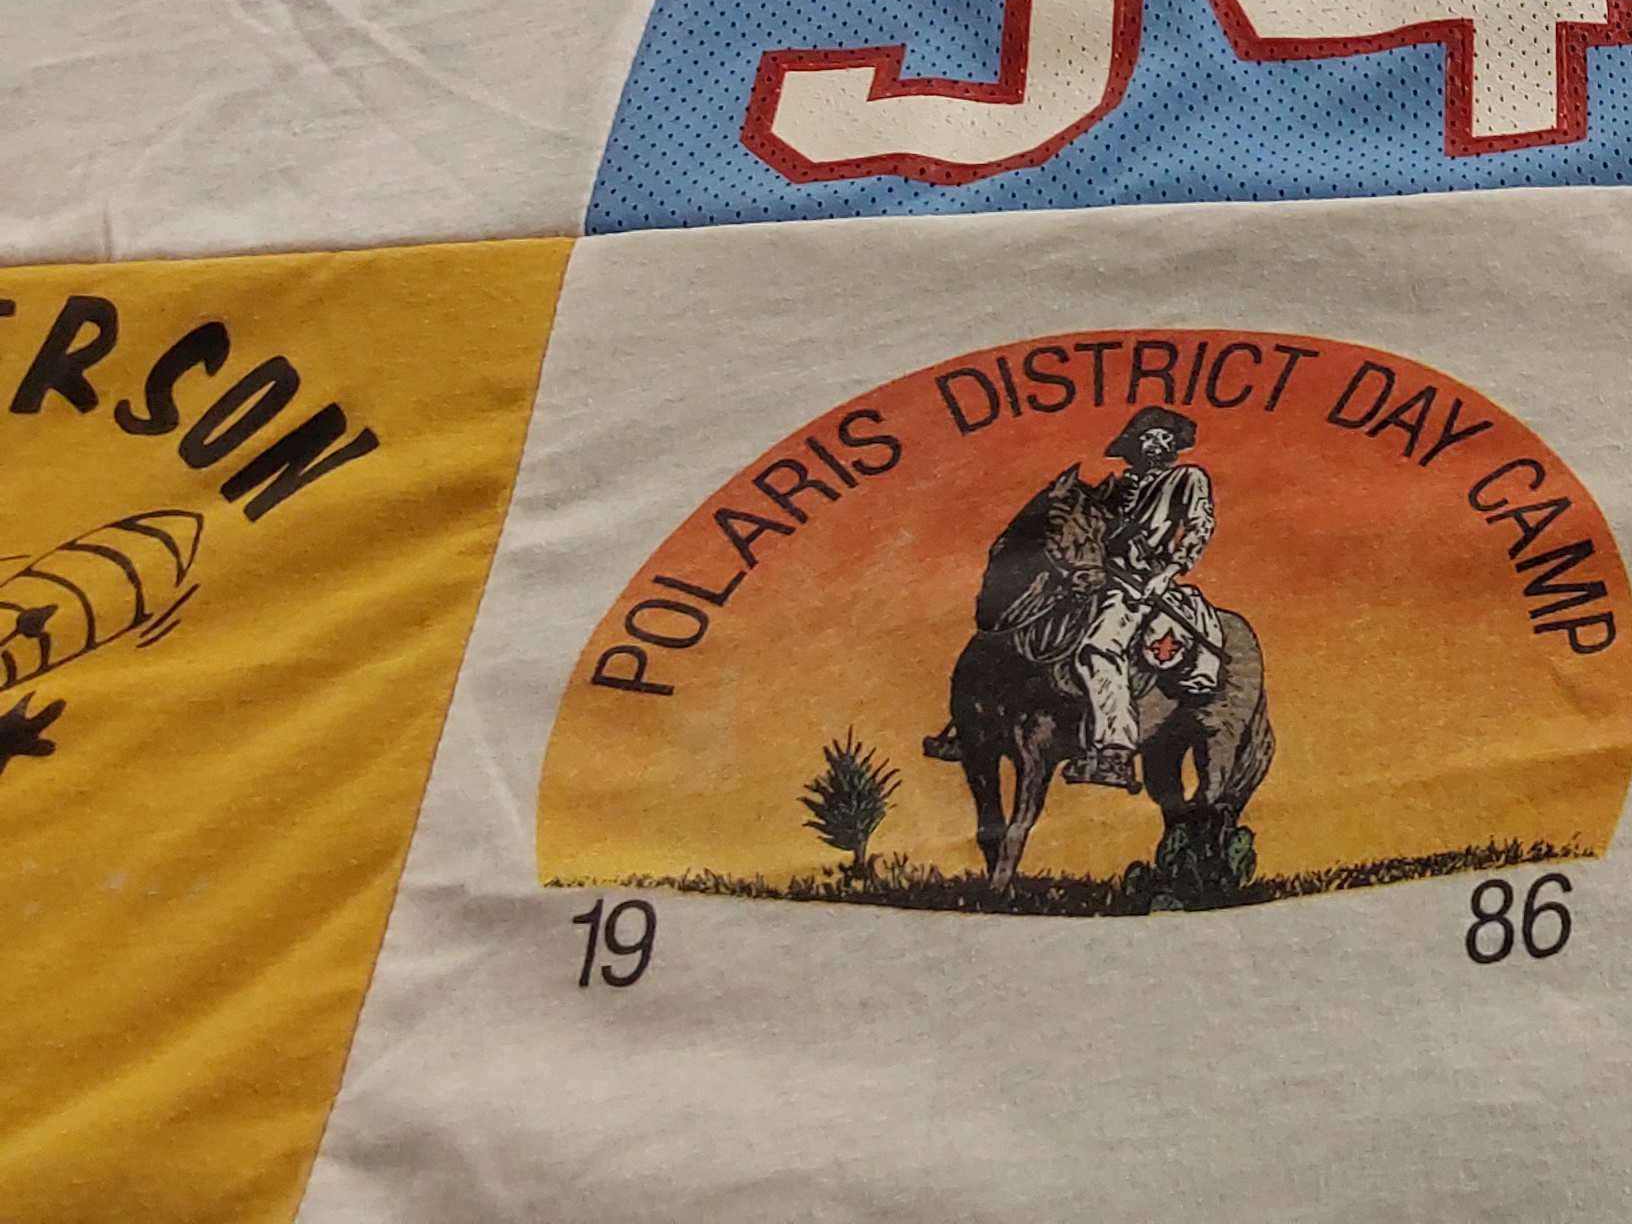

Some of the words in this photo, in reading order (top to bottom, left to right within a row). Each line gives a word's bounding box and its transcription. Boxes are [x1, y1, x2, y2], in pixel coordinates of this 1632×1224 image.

[0, 294, 380, 523] RSON
[590, 407, 903, 696] POLARIS
[935, 340, 1319, 438] DISTRICT
[1328, 360, 1492, 468] DAY
[1466, 456, 1617, 658] CAMP
[572, 897, 656, 989] 19
[1465, 873, 1572, 964] 86
